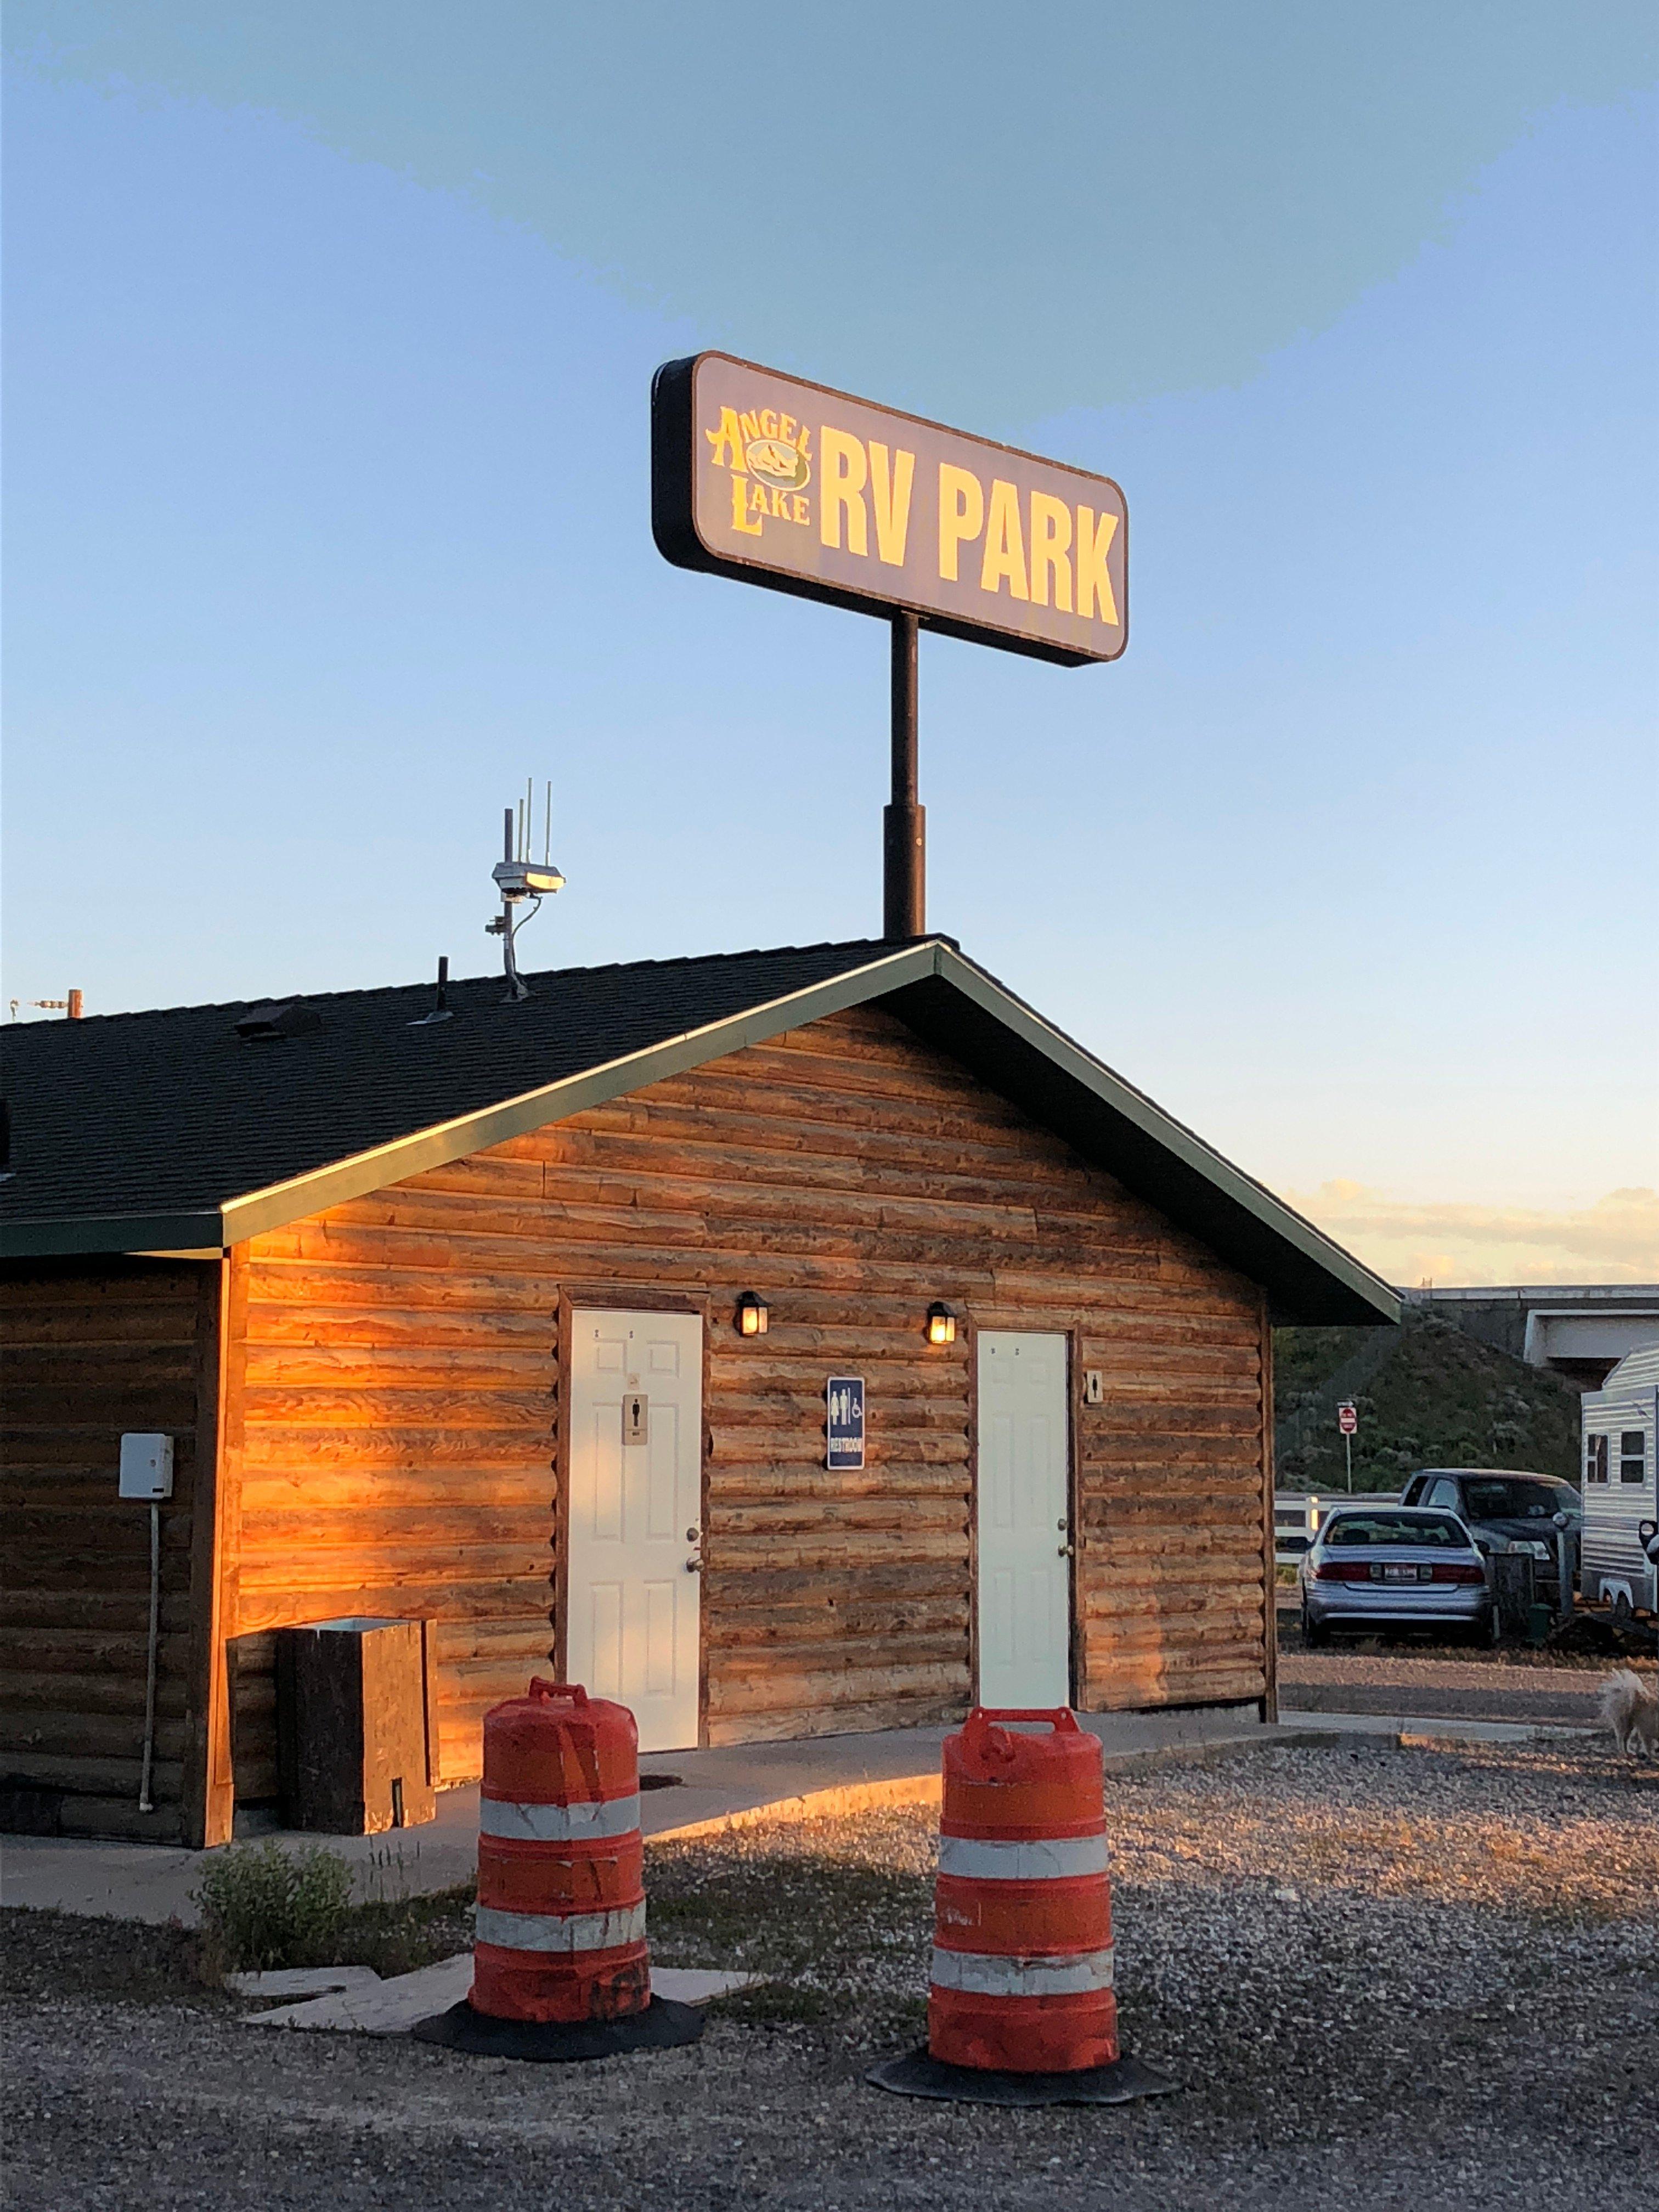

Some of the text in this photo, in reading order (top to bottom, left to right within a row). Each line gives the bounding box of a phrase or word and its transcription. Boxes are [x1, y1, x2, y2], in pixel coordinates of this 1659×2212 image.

[705, 406, 812, 473] ANGEL
[731, 474, 810, 537] LAKE
[821, 425, 1119, 626] RV PARK
